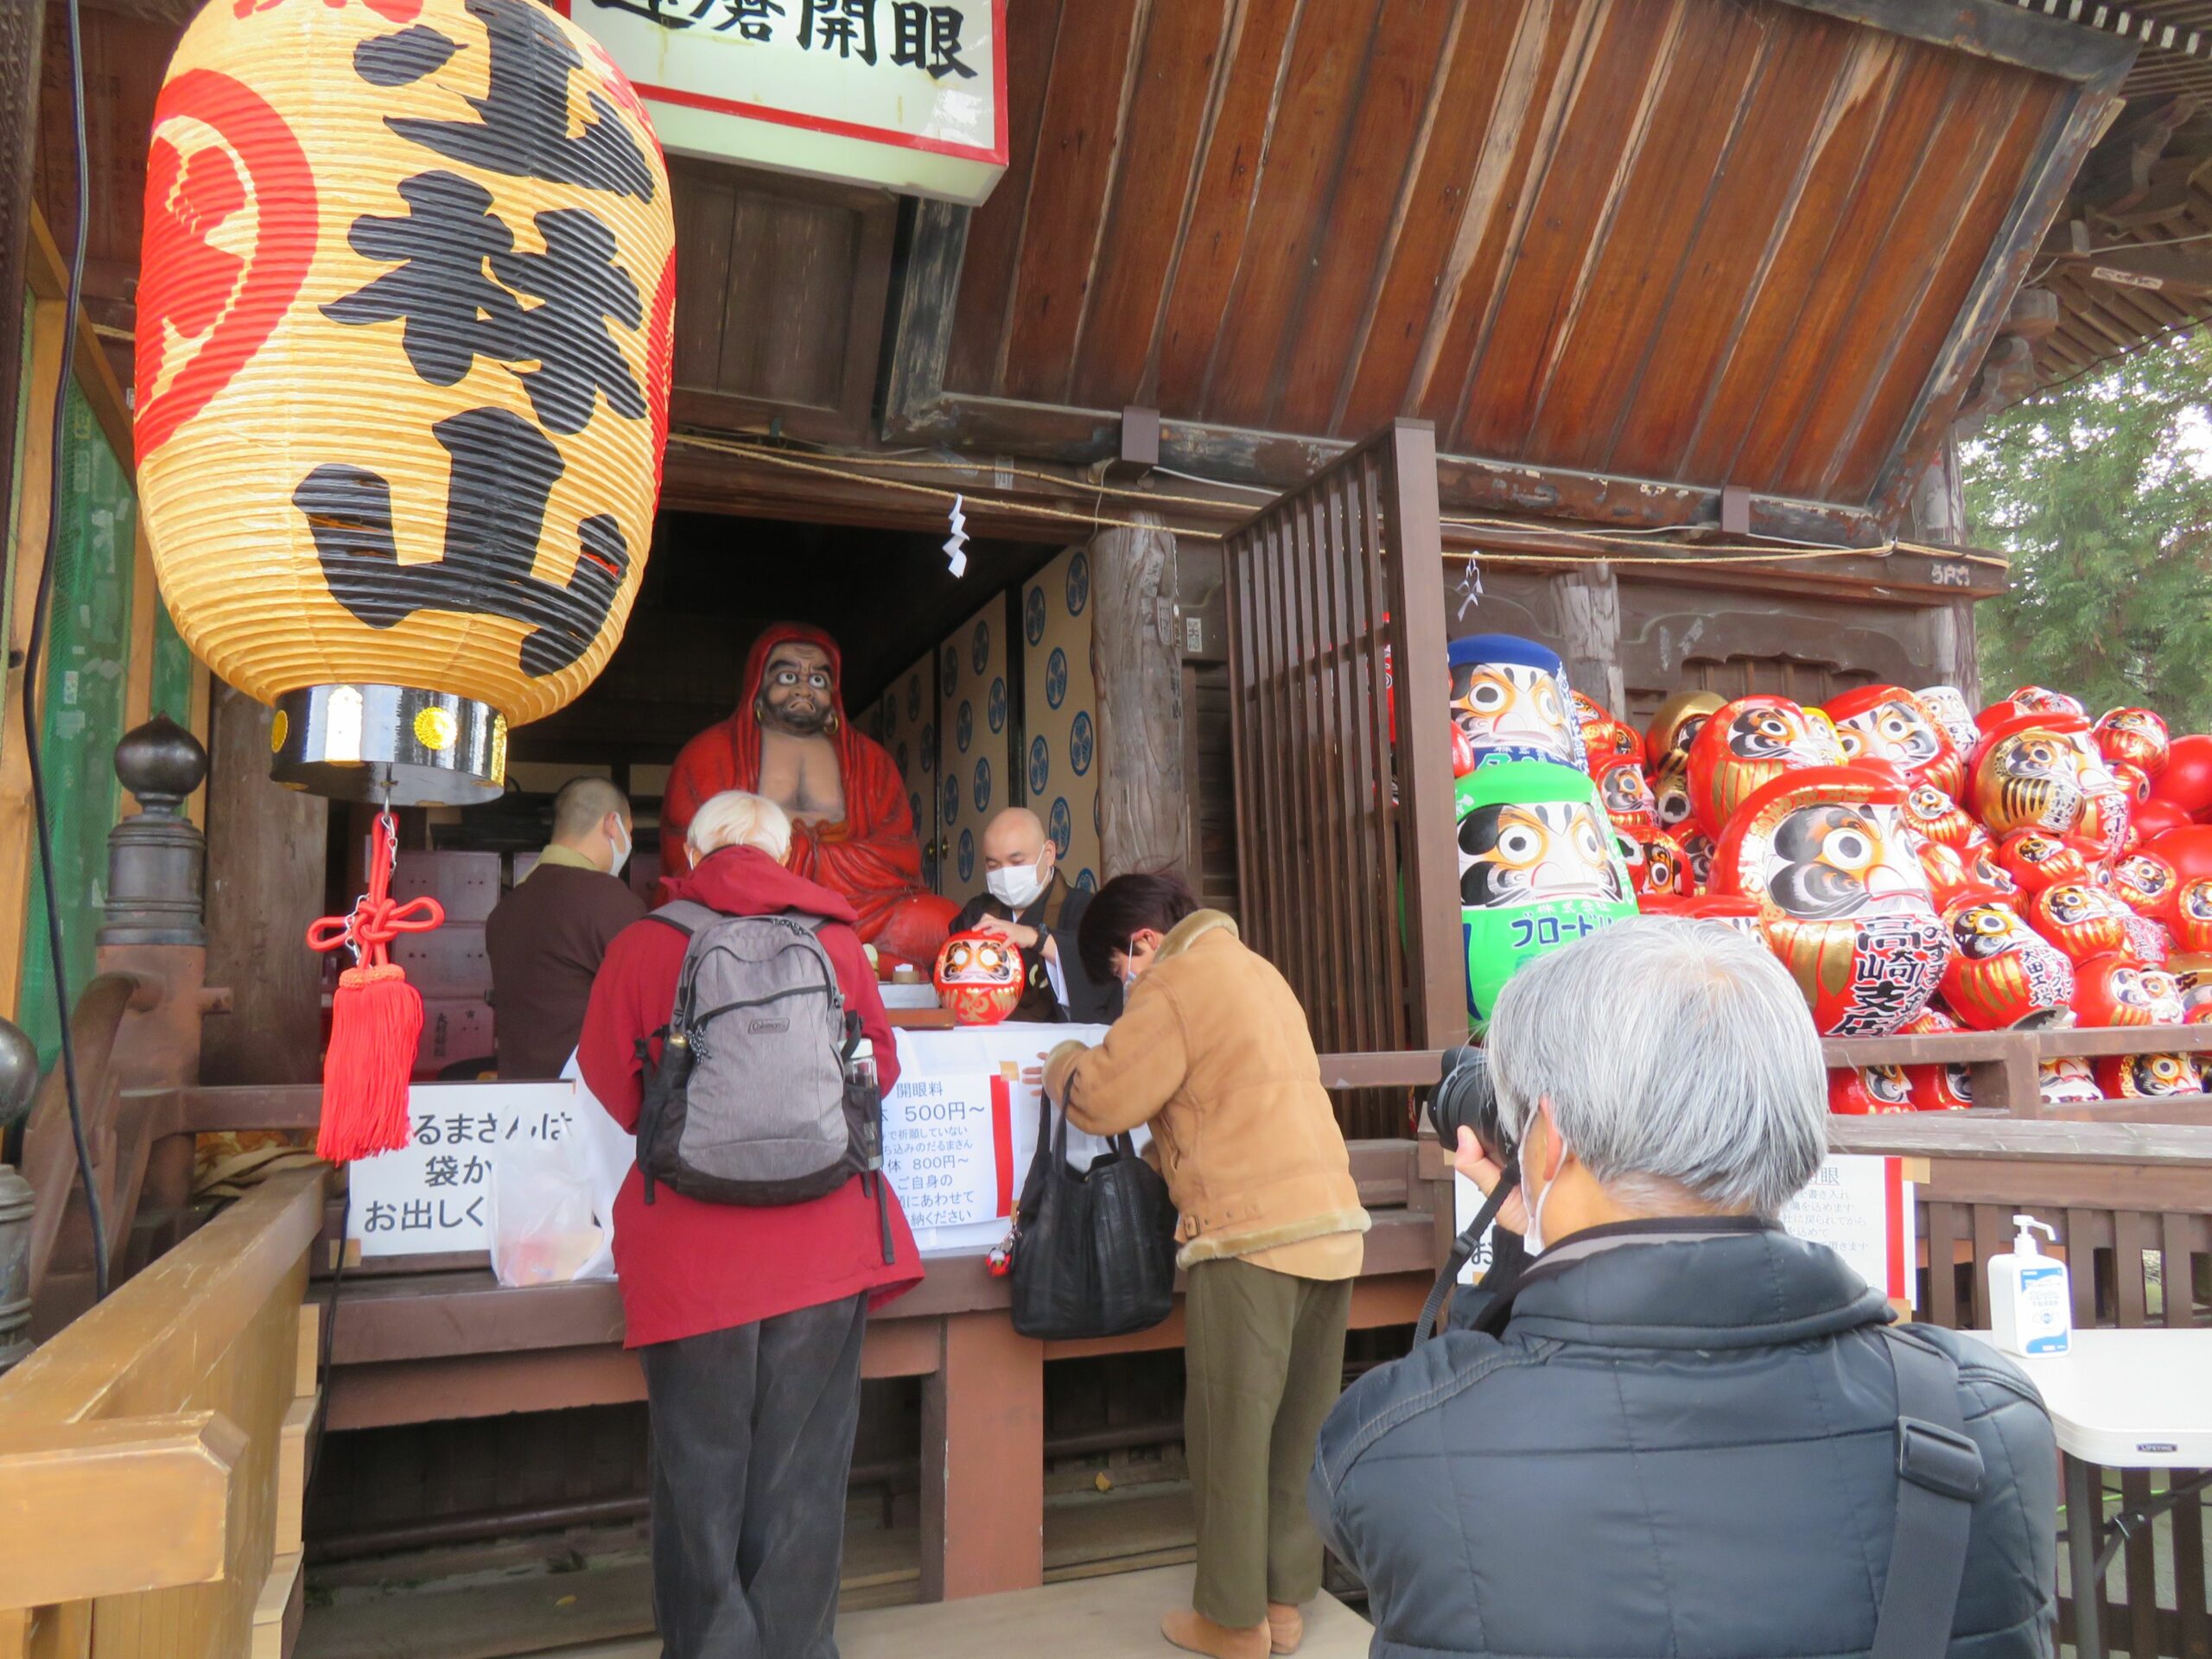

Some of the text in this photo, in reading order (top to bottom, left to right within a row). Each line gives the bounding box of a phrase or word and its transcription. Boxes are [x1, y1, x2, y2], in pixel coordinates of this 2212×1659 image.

[896, 1081, 944, 1099] 開眼料
[881, 1126, 968, 1141] で祈願していない
[898, 1173, 953, 1190] ご自身の
[364, 1196, 485, 1233] お出しく
[906, 1209, 972, 1227] 納ください
